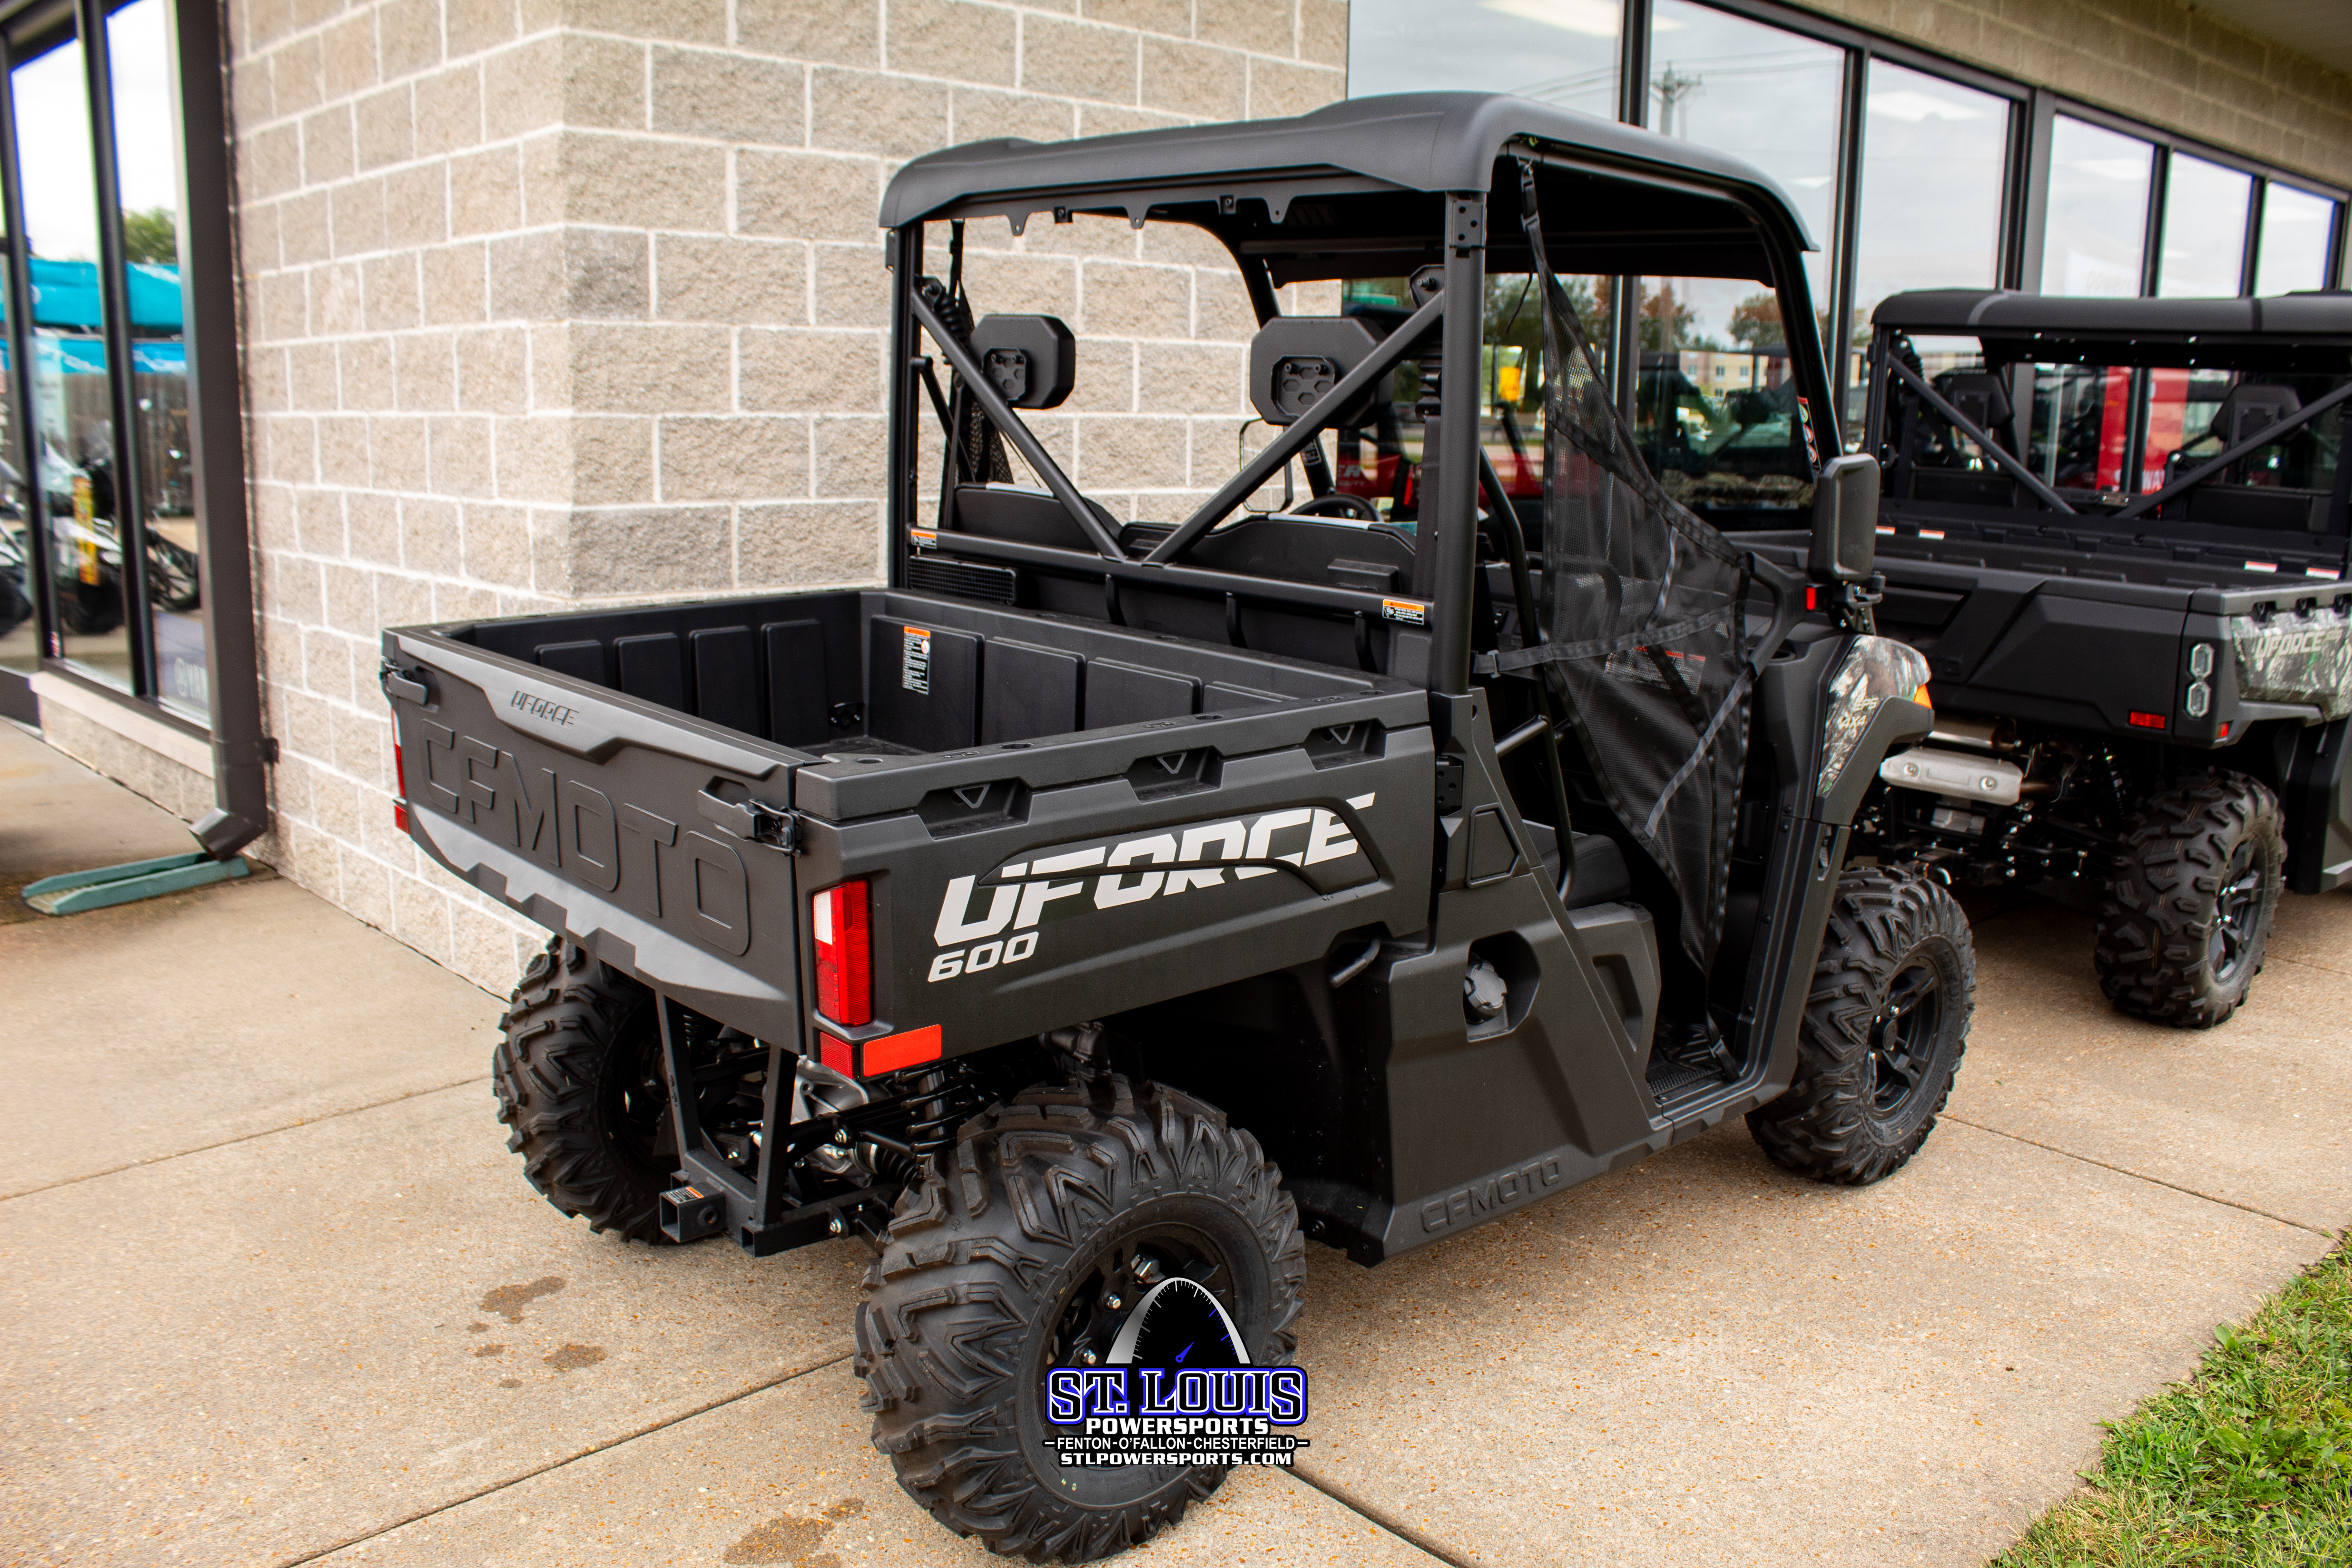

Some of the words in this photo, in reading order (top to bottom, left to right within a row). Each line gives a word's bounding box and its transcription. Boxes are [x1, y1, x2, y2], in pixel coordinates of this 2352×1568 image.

[2255, 631, 2326, 659] UFORCE
[510, 690, 580, 727] UFORCE
[1852, 697, 1879, 712] EPS
[420, 719, 750, 956] CFMOTO
[934, 792, 1376, 947] UFORCE
[928, 931, 1039, 982] 600
[1421, 1155, 1563, 1233] CFMOTO
